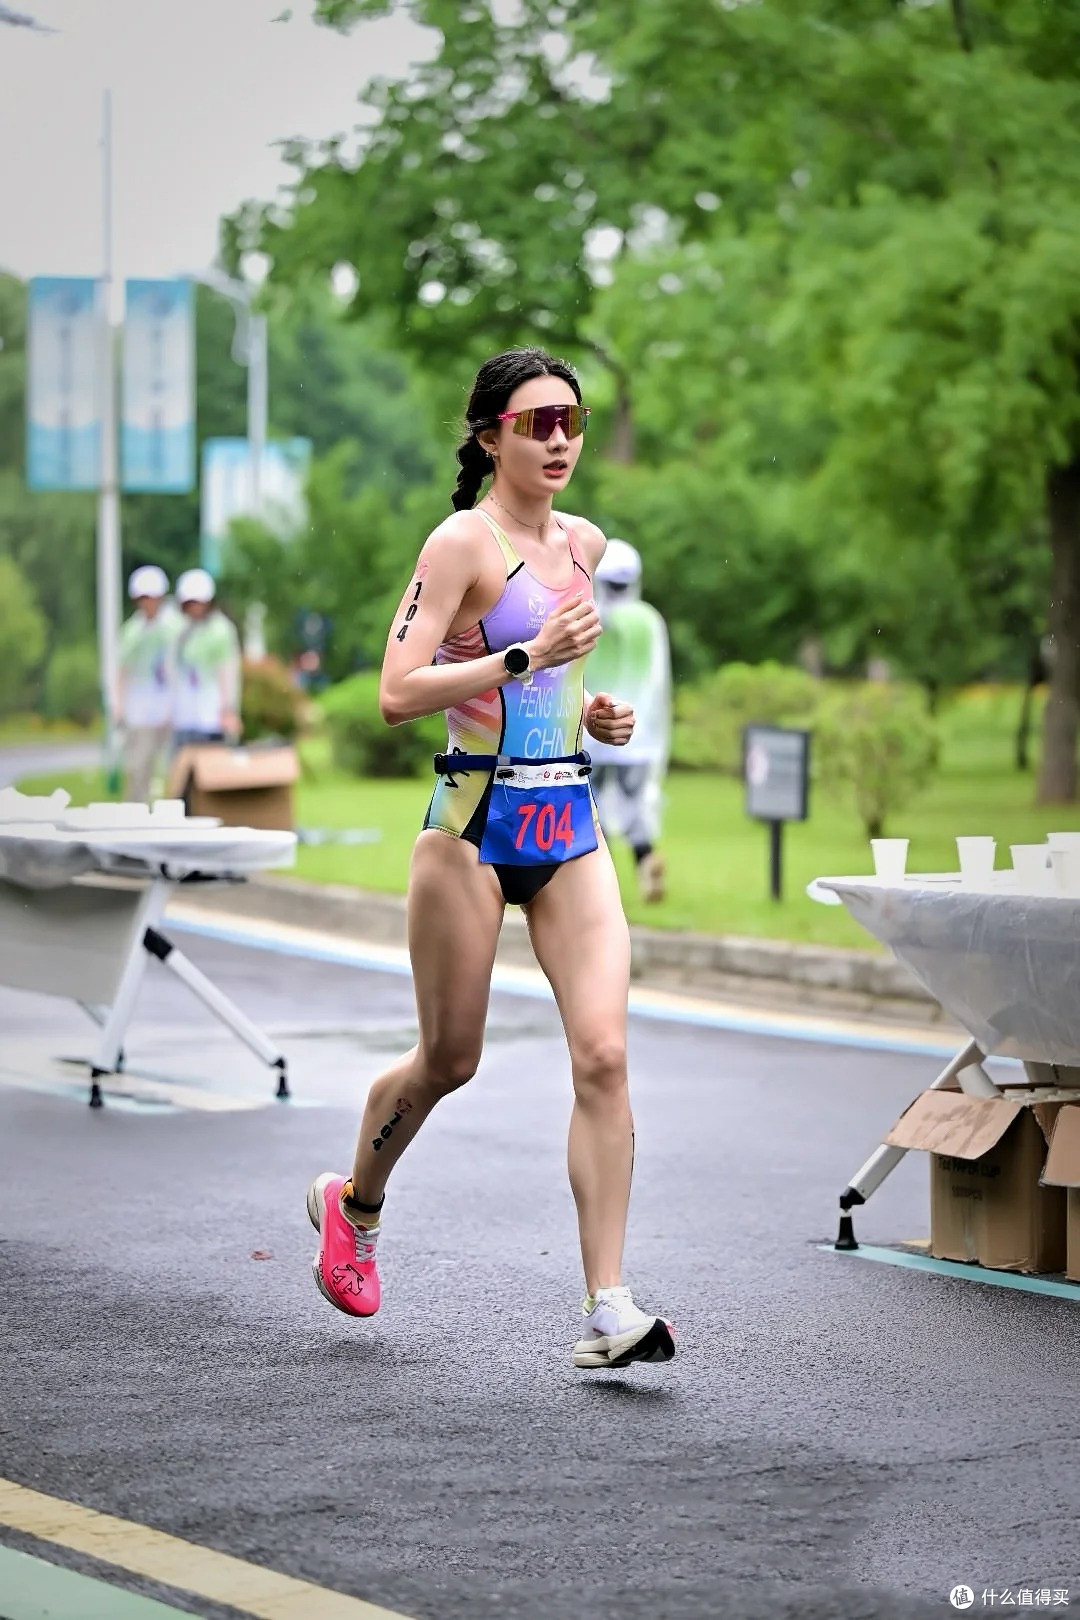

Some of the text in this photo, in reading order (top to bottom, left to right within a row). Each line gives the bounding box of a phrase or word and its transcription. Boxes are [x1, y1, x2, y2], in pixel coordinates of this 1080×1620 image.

[517, 686, 554, 719] FENG
[524, 727, 567, 758] CHN
[514, 802, 574, 851] 704
